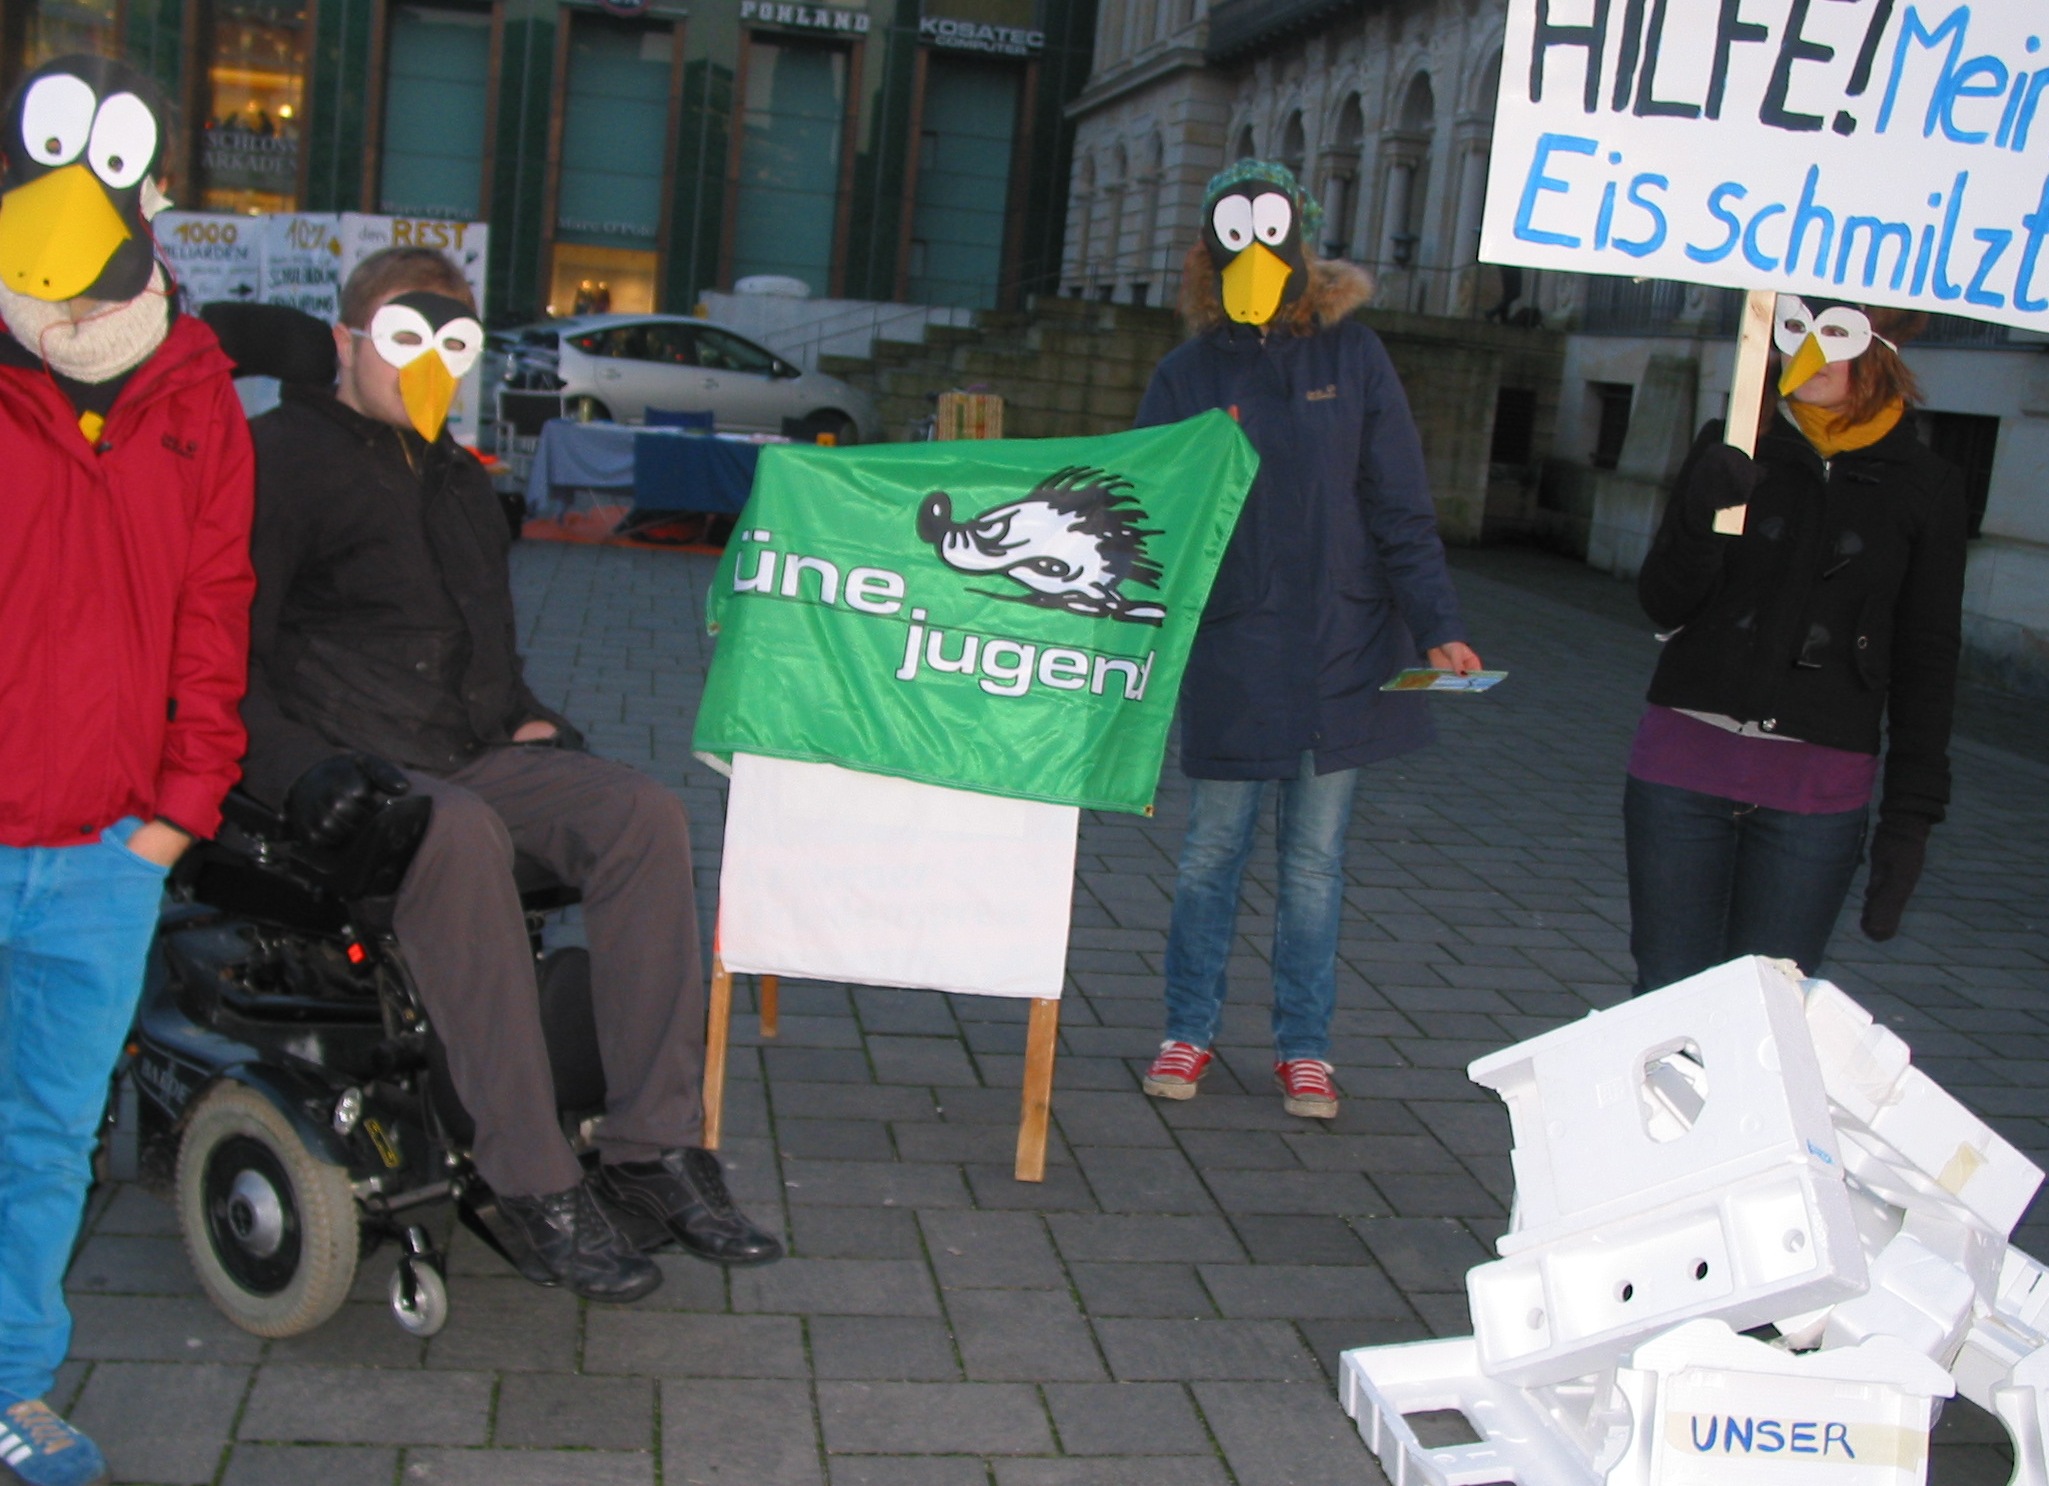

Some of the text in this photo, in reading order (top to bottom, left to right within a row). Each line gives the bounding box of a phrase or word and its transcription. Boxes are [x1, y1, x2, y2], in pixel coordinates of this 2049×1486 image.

[920, 19, 1045, 48] KOSATEC
[1529, 0, 1893, 136] HILFE!
[1513, 132, 1669, 258] Eis
[174, 221, 238, 245] 1000
[391, 218, 468, 251] REST
[733, 529, 906, 615] üne
[1691, 1415, 1855, 1460] UNSER
